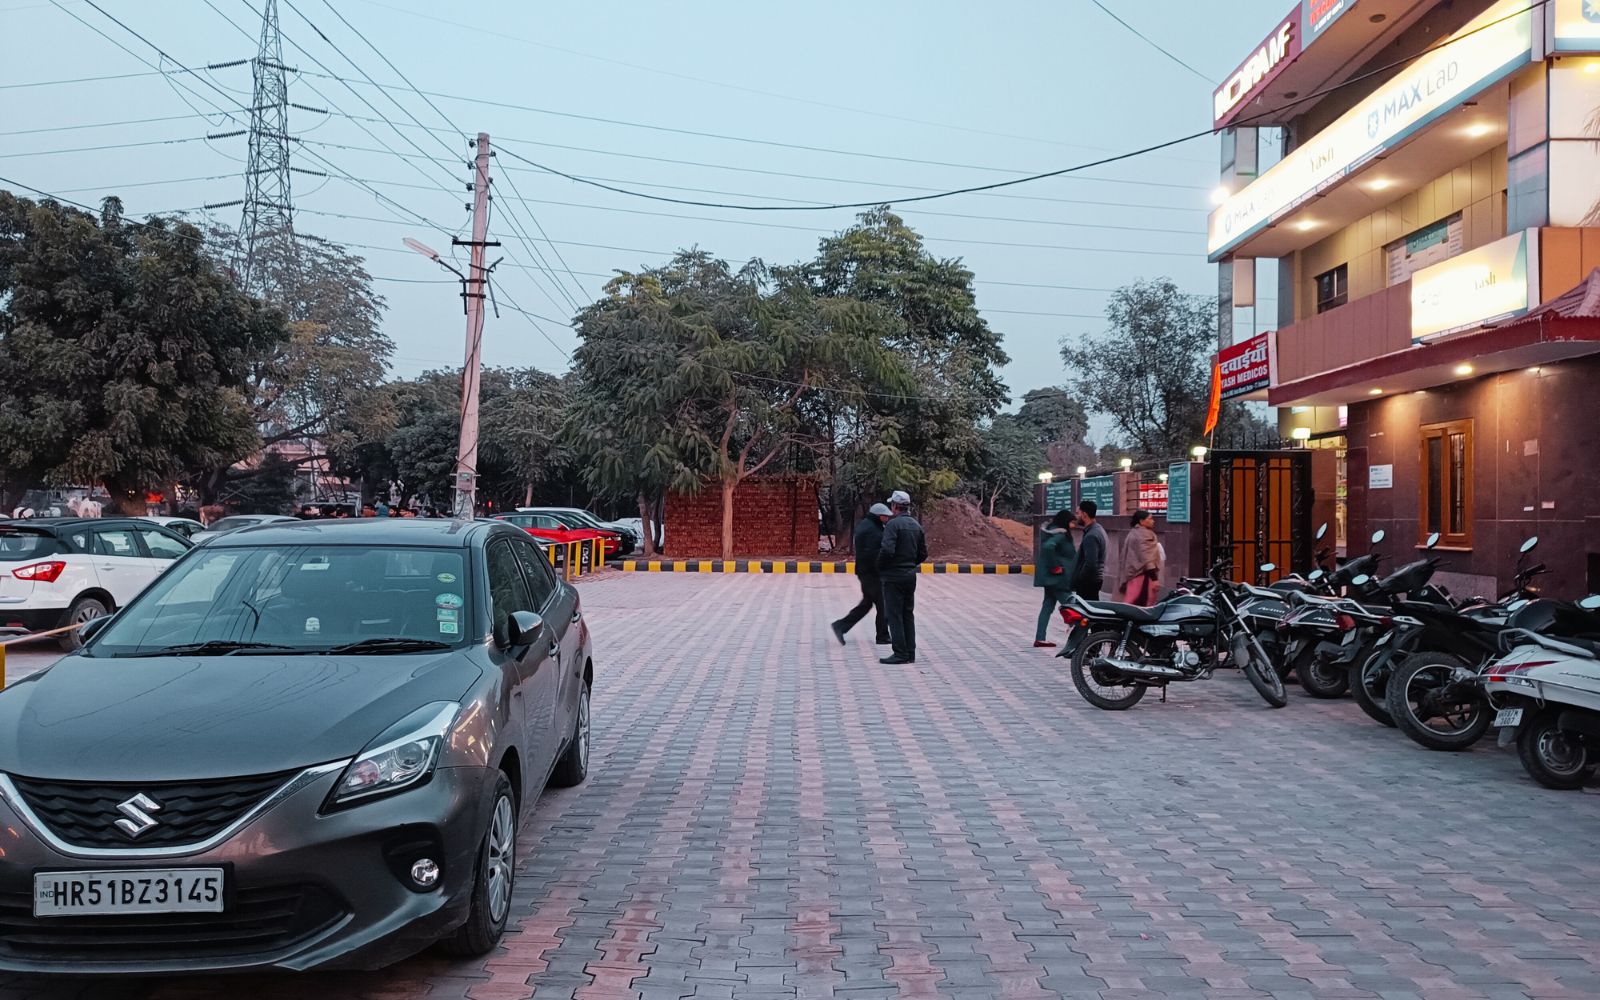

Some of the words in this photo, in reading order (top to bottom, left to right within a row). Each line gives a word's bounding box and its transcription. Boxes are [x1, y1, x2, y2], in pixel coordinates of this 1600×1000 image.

[1384, 80, 1422, 124] MAX
[1427, 61, 1458, 96] Lab
[1237, 364, 1268, 384] MEDICOS
[40, 890, 54, 898] IND
[54, 878, 217, 906] HR51BZ3145
